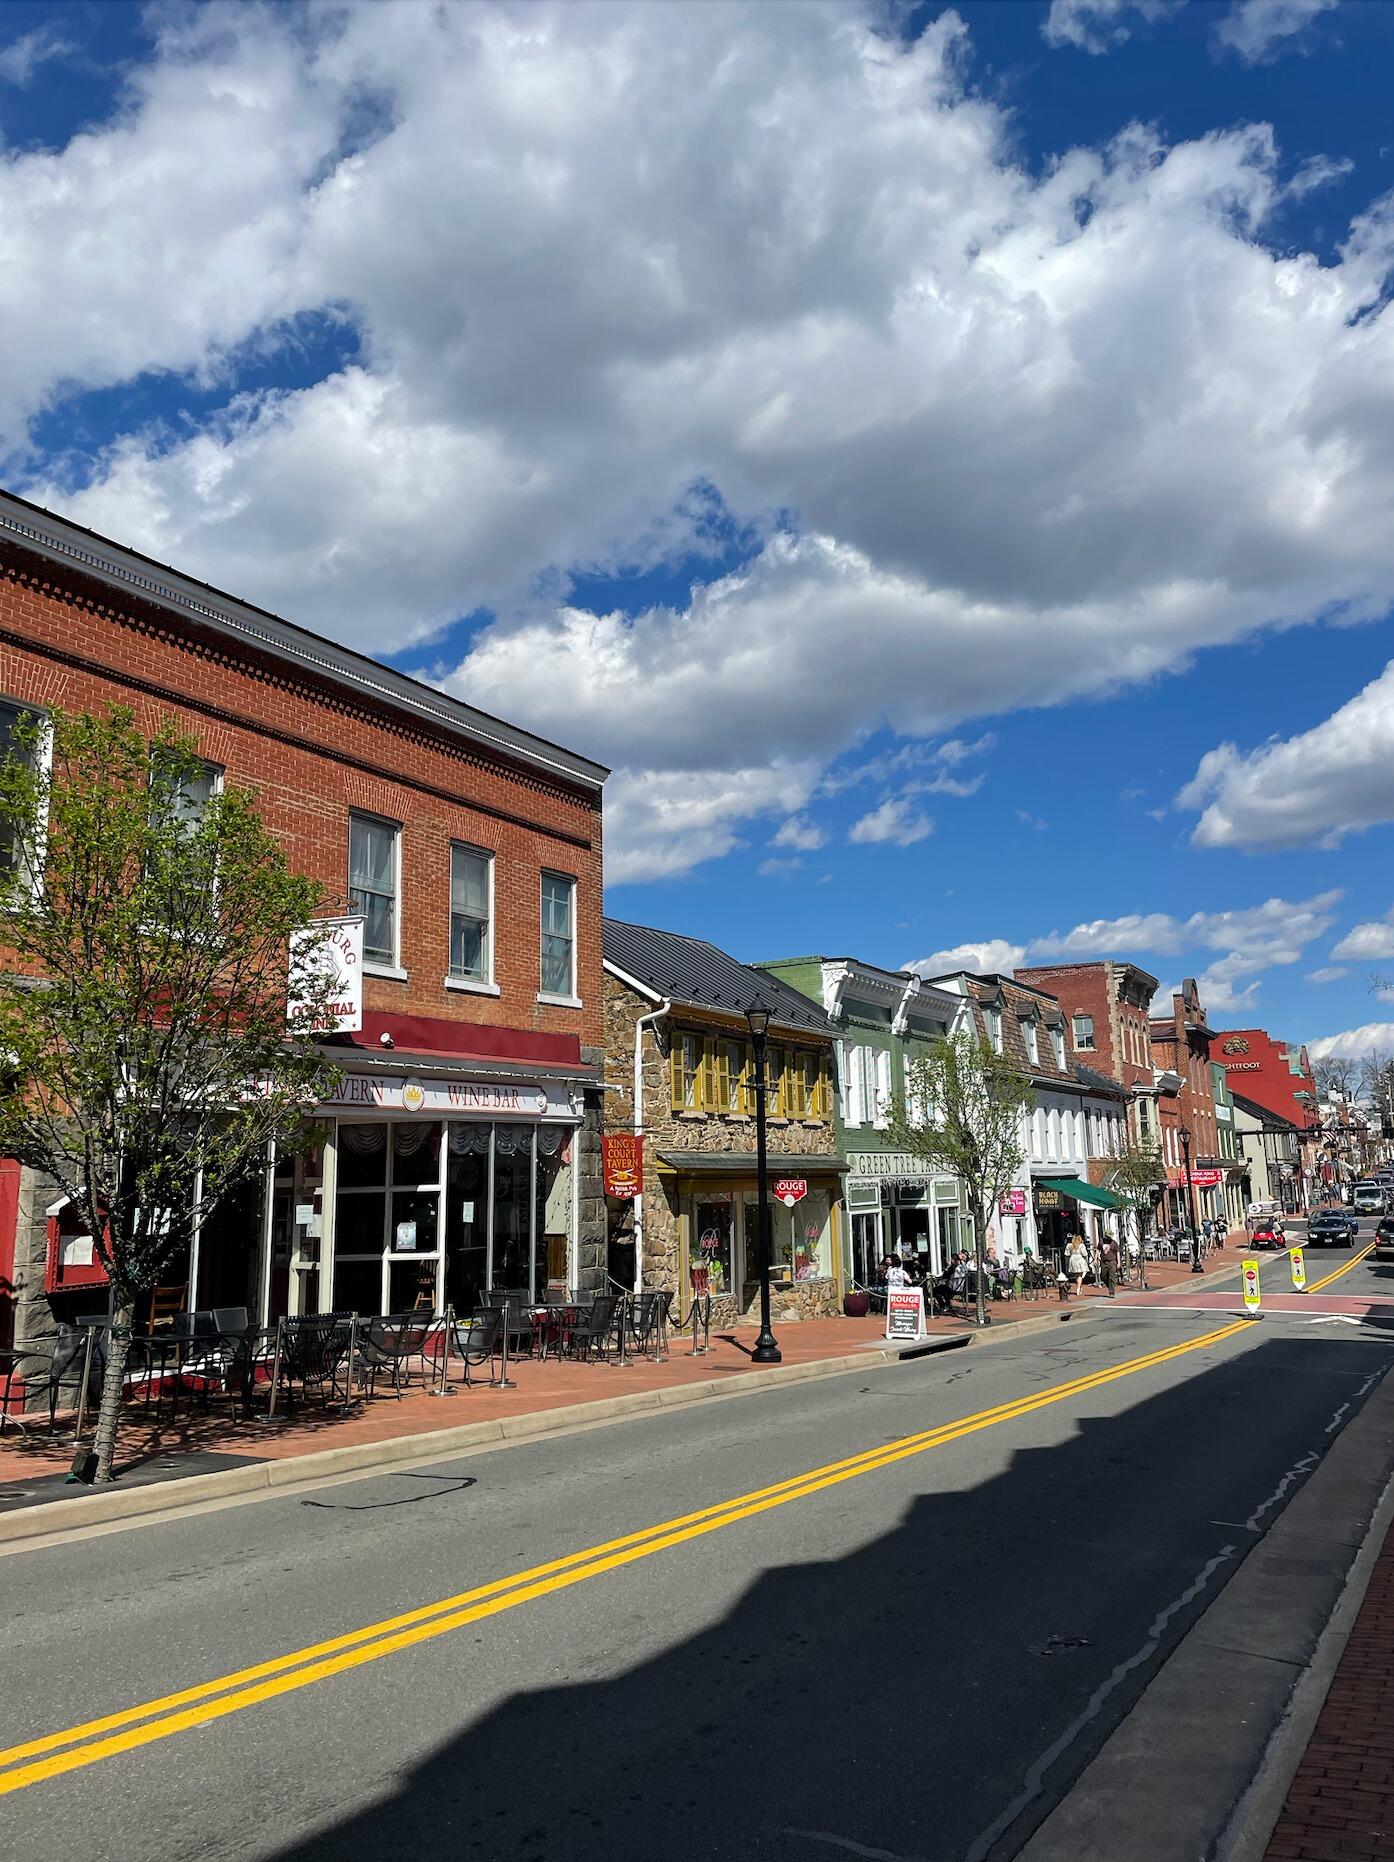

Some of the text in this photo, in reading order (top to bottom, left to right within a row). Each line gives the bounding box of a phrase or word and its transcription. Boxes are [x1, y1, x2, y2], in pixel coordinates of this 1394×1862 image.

[448, 1085, 521, 1111] WINE BAR
[608, 1139, 636, 1149] KING'S
[607, 1159, 639, 1169] TAVERN
[860, 1155, 891, 1174] GREEN
[894, 1155, 917, 1174] TREE
[774, 1182, 804, 1191] ROUGE
[890, 1295, 920, 1304] ROUGE
